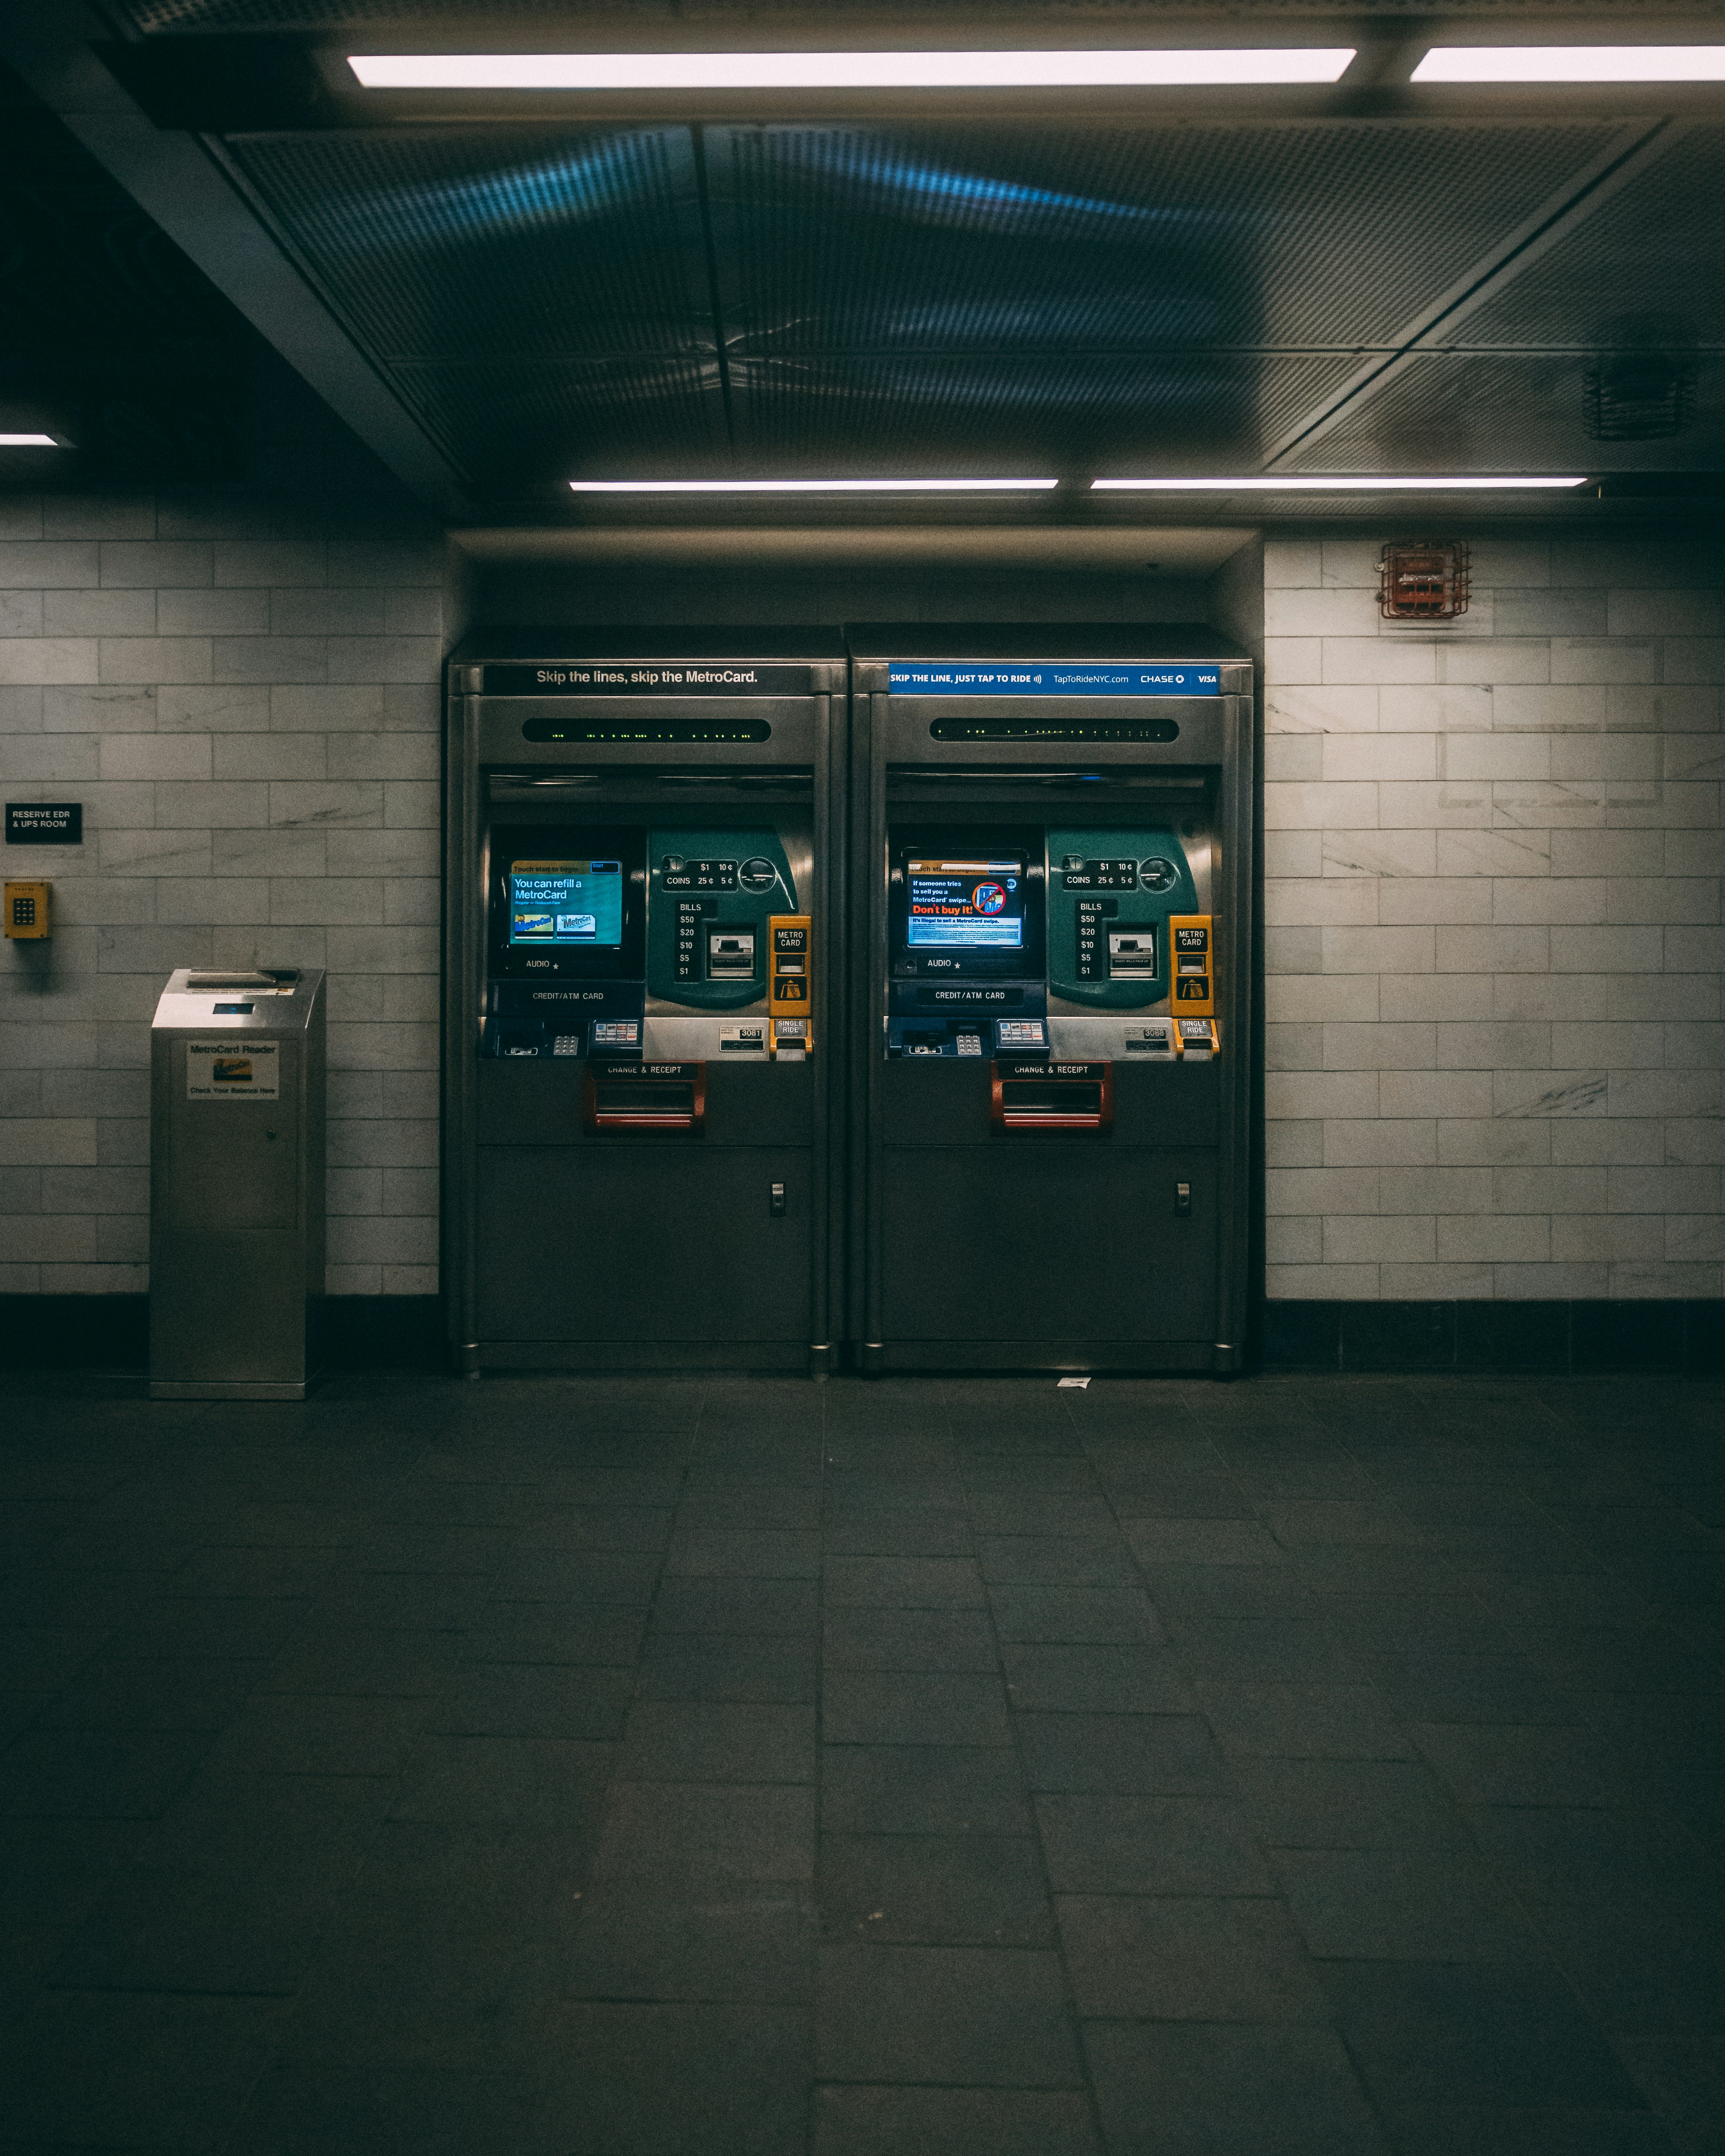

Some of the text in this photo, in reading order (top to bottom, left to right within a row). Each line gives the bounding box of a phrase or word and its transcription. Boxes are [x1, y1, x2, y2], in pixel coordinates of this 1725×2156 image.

[537, 670, 757, 685] Skip the lines, skip the MetroCard.
[931, 675, 953, 683] LINE,
[955, 675, 975, 684] JUST
[1053, 675, 1129, 684] TapToRideNYC.com
[515, 879, 532, 888] You
[553, 879, 574, 888] refill
[515, 890, 567, 899] MetroCard
[912, 904, 939, 914] Don't
[942, 906, 960, 915] buy
[563, 915, 591, 928] MetroCard
[191, 1045, 275, 1054] MetroCard Reader
